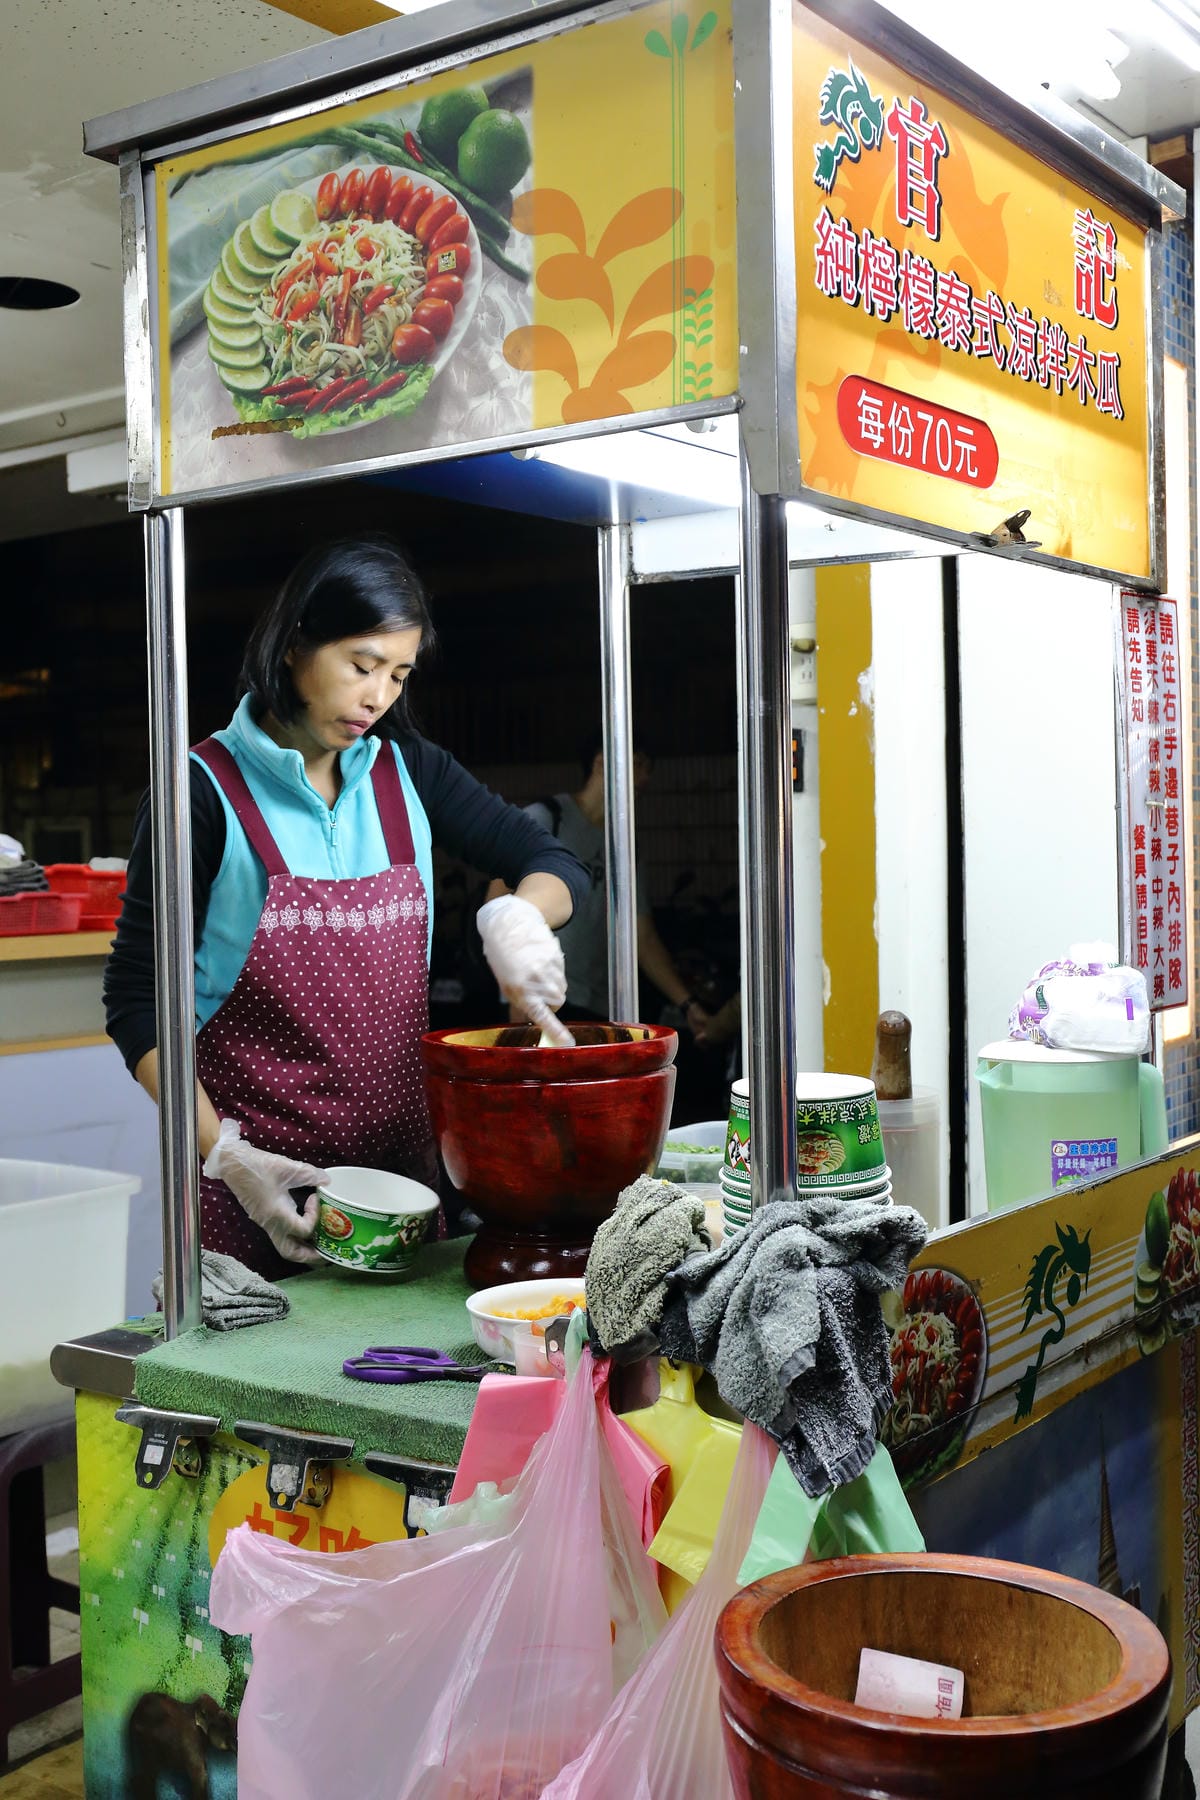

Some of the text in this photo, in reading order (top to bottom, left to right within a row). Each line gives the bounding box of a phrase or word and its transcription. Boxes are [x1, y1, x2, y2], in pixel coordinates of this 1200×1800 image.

[888, 95, 1120, 330] 官 記
[814, 205, 1125, 420] 純檸檬泰式涼拌木瓜
[856, 388, 979, 480] 每份70元
[1133, 823, 1150, 969] 餐具請自取
